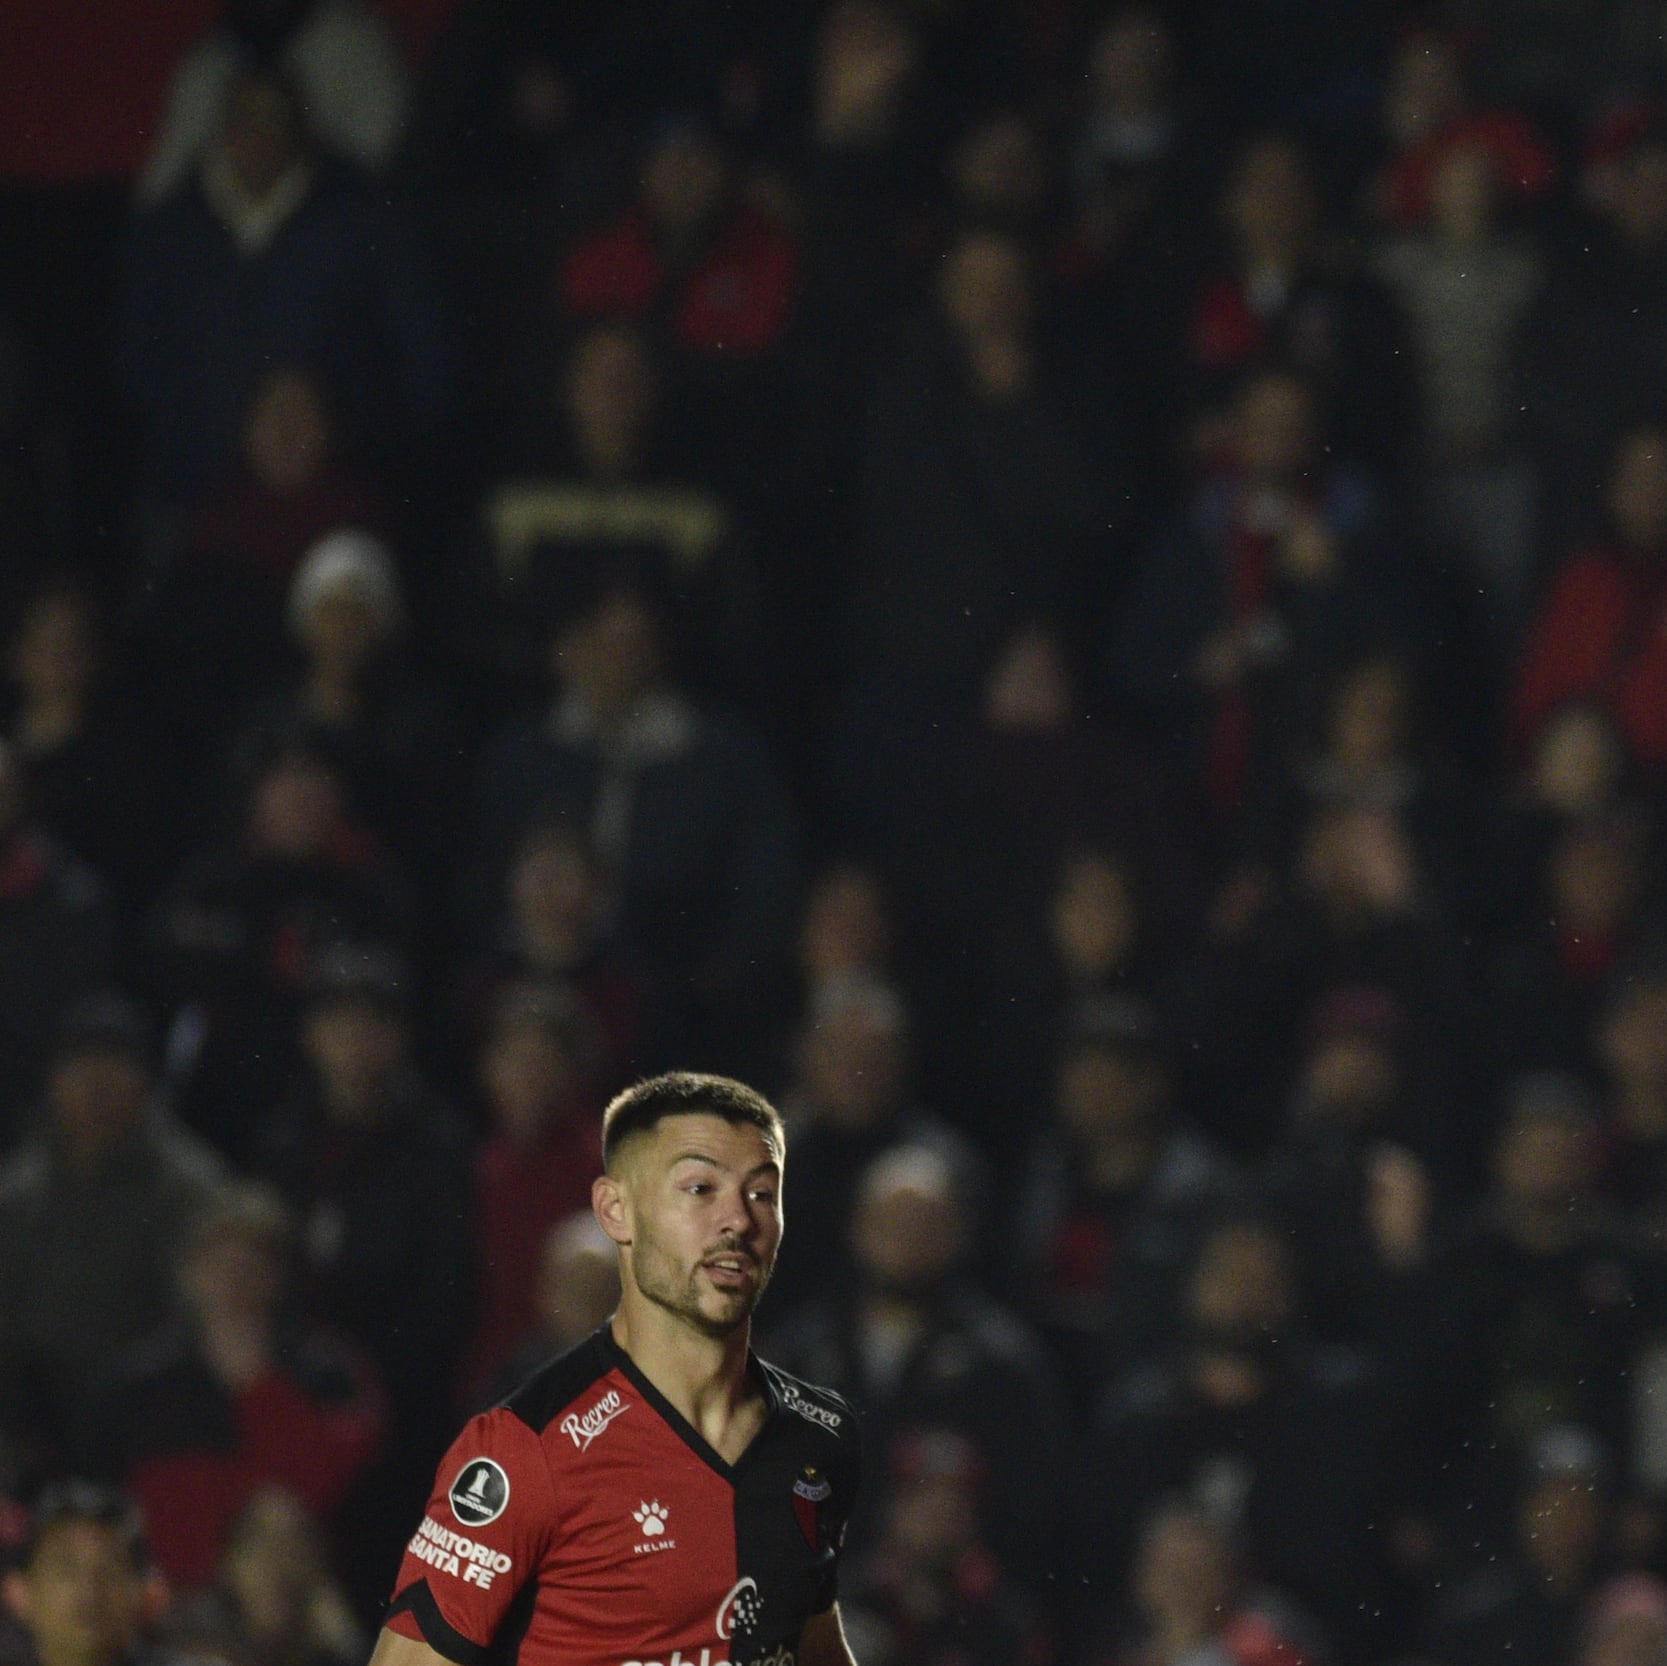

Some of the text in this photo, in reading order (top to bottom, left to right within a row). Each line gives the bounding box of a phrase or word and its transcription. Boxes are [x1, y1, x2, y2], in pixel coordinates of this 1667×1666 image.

[560, 1390, 630, 1453] Recreo
[774, 1385, 843, 1438] Recreo
[407, 1534, 495, 1600] SANTA FE
[418, 1515, 512, 1573] SANATORIO
[634, 1540, 676, 1554] KELME
